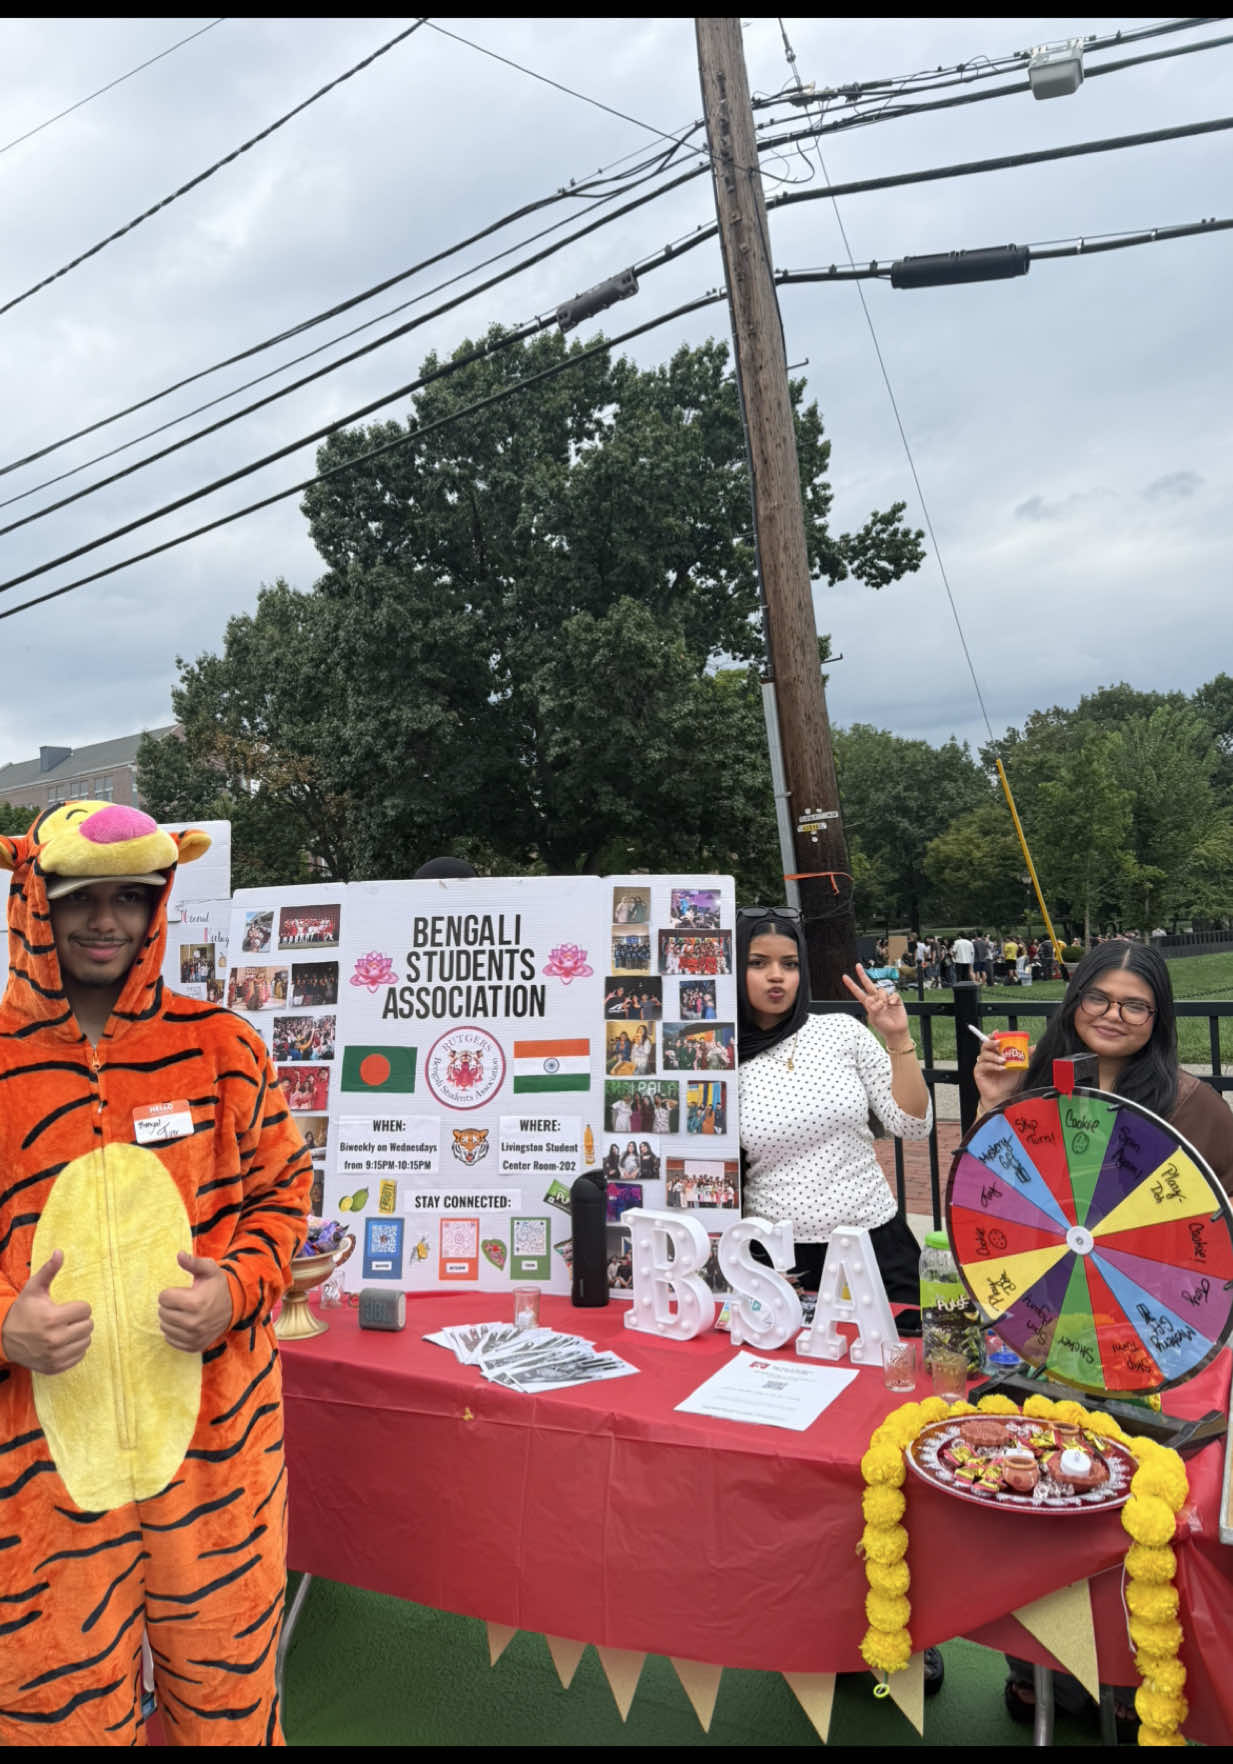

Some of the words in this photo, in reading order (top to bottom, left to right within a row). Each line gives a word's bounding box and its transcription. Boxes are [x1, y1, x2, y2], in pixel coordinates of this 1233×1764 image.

[413, 914, 522, 948] BENGALI
[406, 948, 536, 983] STUDENTS
[382, 984, 546, 1019] ASSOCIATION
[441, 1034, 492, 1052] RUTGERS
[149, 1103, 174, 1114] HELLO
[373, 1119, 407, 1132] WHEN:
[519, 1119, 561, 1132] WHERE:
[1065, 1108, 1101, 1134] Cookie
[339, 1142, 375, 1154] Biweekly
[377, 1144, 387, 1152] on
[389, 1142, 438, 1153] Wednesdays
[501, 1142, 543, 1154] Livingston
[545, 1142, 578, 1153] Student
[344, 1160, 363, 1170] from
[365, 1160, 432, 1170] 9:15PM-10:15PM
[502, 1160, 531, 1171] Center
[533, 1160, 576, 1171] Room-202
[414, 1195, 441, 1209] STAY
[443, 1194, 512, 1209] CONNECTED:
[620, 1207, 900, 1365] BSA
